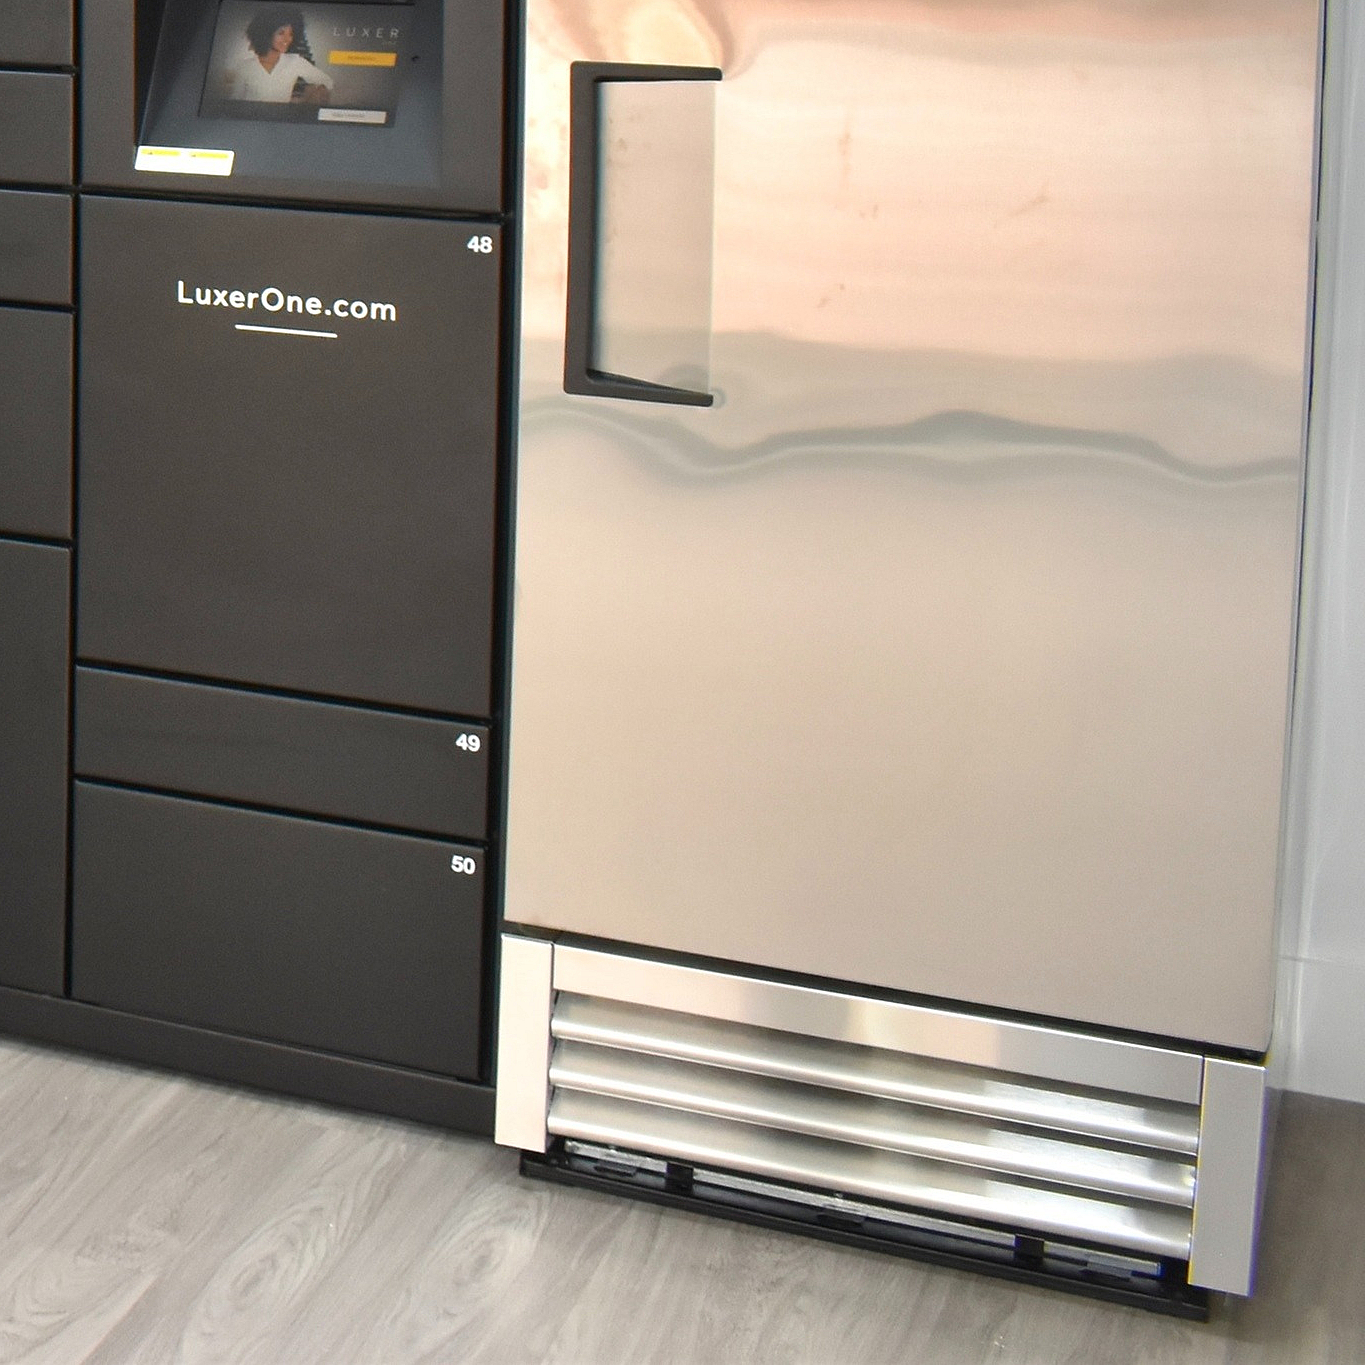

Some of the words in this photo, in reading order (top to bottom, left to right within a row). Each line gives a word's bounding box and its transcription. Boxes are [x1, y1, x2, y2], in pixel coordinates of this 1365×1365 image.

[333, 26, 401, 39] LUXER
[466, 235, 493, 254] 48
[176, 279, 398, 322] LuxerOne.com
[455, 733, 481, 753] 49
[450, 854, 476, 875] 50
